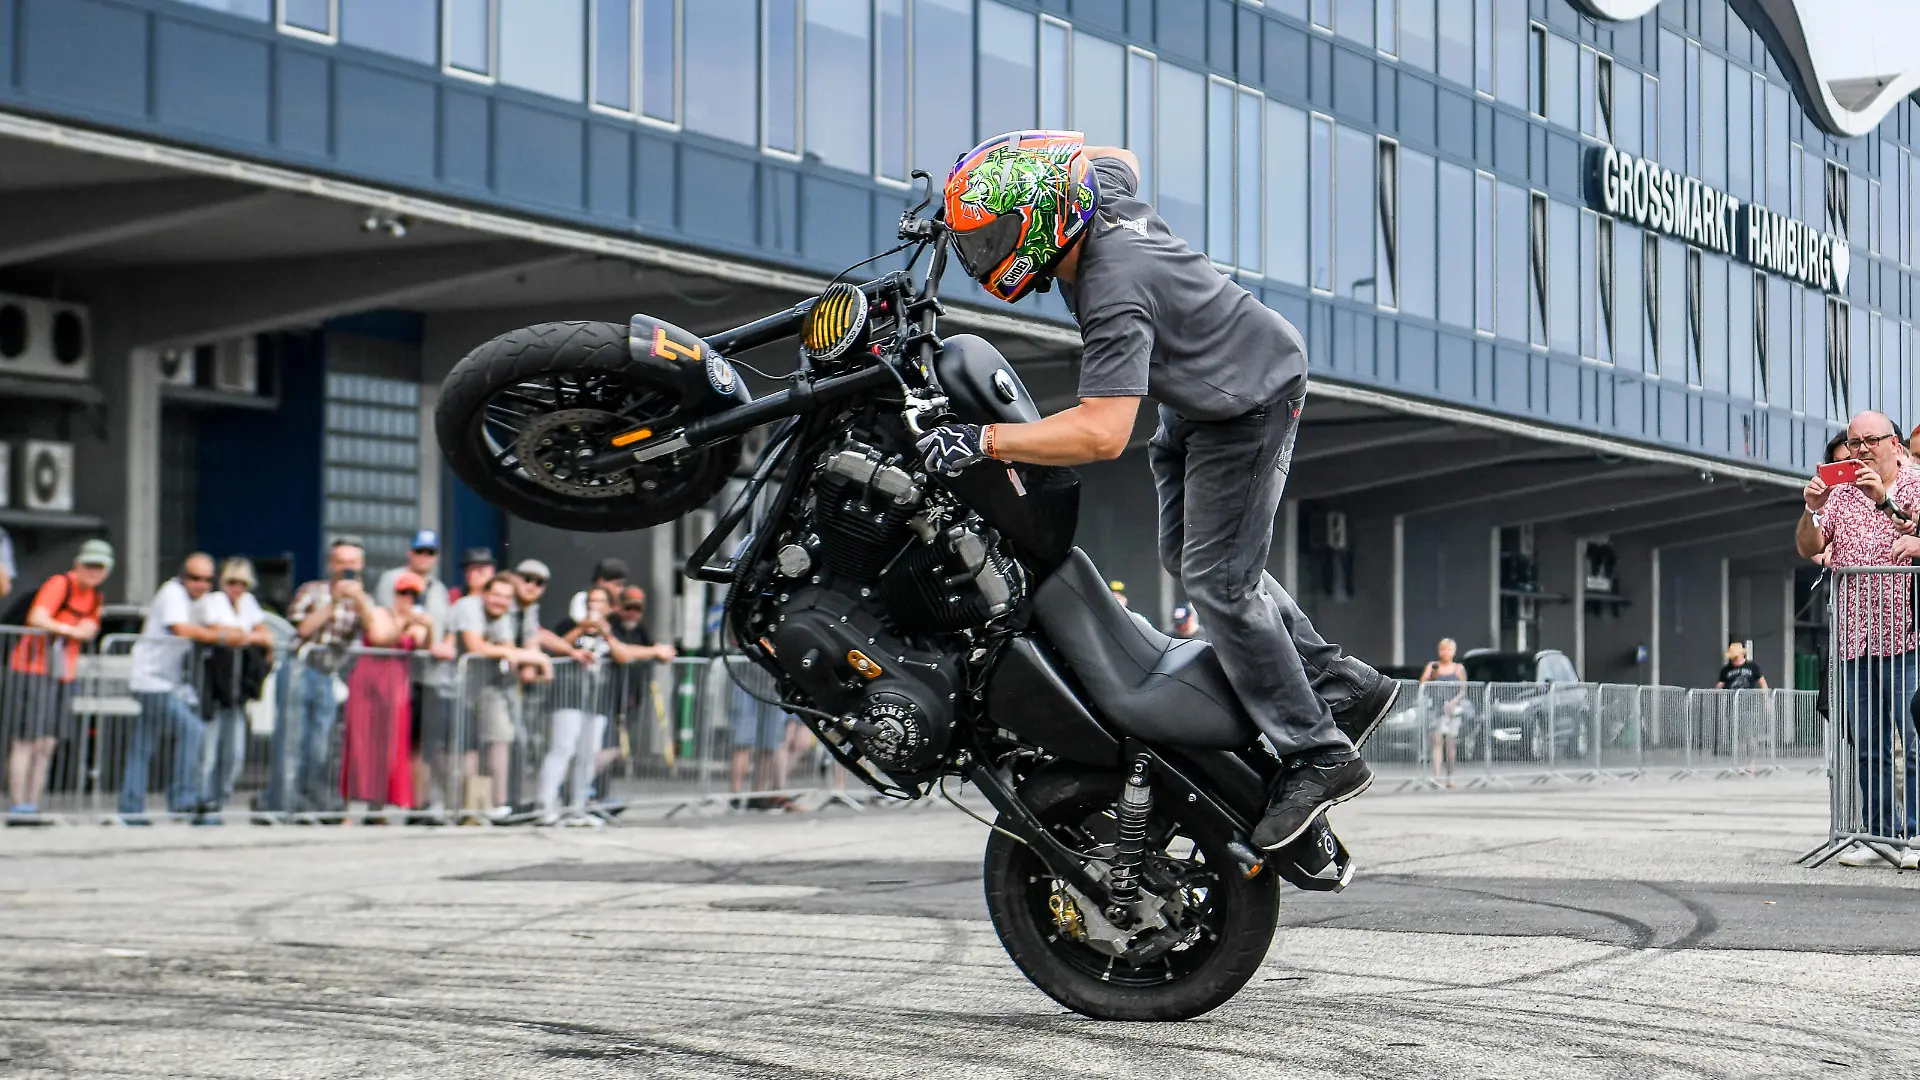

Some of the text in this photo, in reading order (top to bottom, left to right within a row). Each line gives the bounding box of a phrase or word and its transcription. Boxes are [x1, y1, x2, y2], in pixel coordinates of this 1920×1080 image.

[1603, 147, 1832, 291] GROSSMARKT HAMBURG
[1004, 260, 1028, 284] SHOEI
[872, 706, 917, 746] GAME OVER
